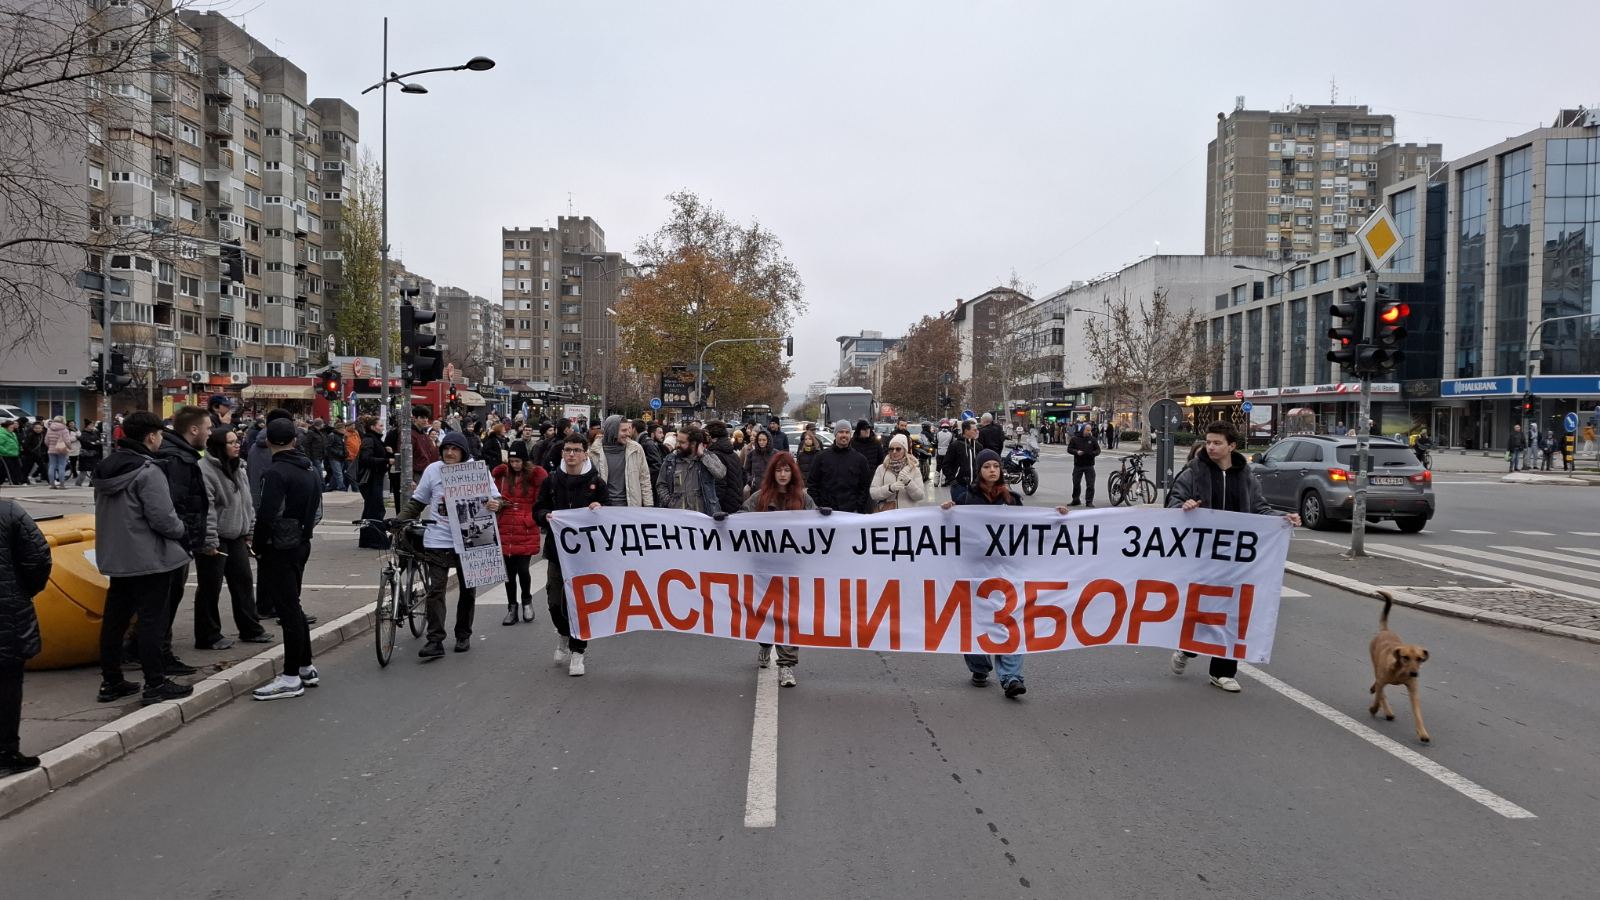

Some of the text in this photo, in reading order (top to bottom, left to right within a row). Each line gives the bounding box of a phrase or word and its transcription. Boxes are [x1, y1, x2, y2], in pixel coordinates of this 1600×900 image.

[1462, 381, 1498, 392] HALKBANK
[445, 472, 487, 486] КАЖЊЕНИ
[560, 524, 1259, 563] СТУДЕНТИ ИМАЈУ ЈЕДАН ХИТАН ЗАХТЕВ
[571, 569, 1254, 659] РАСПИШИ ИЗБОРЕ!
